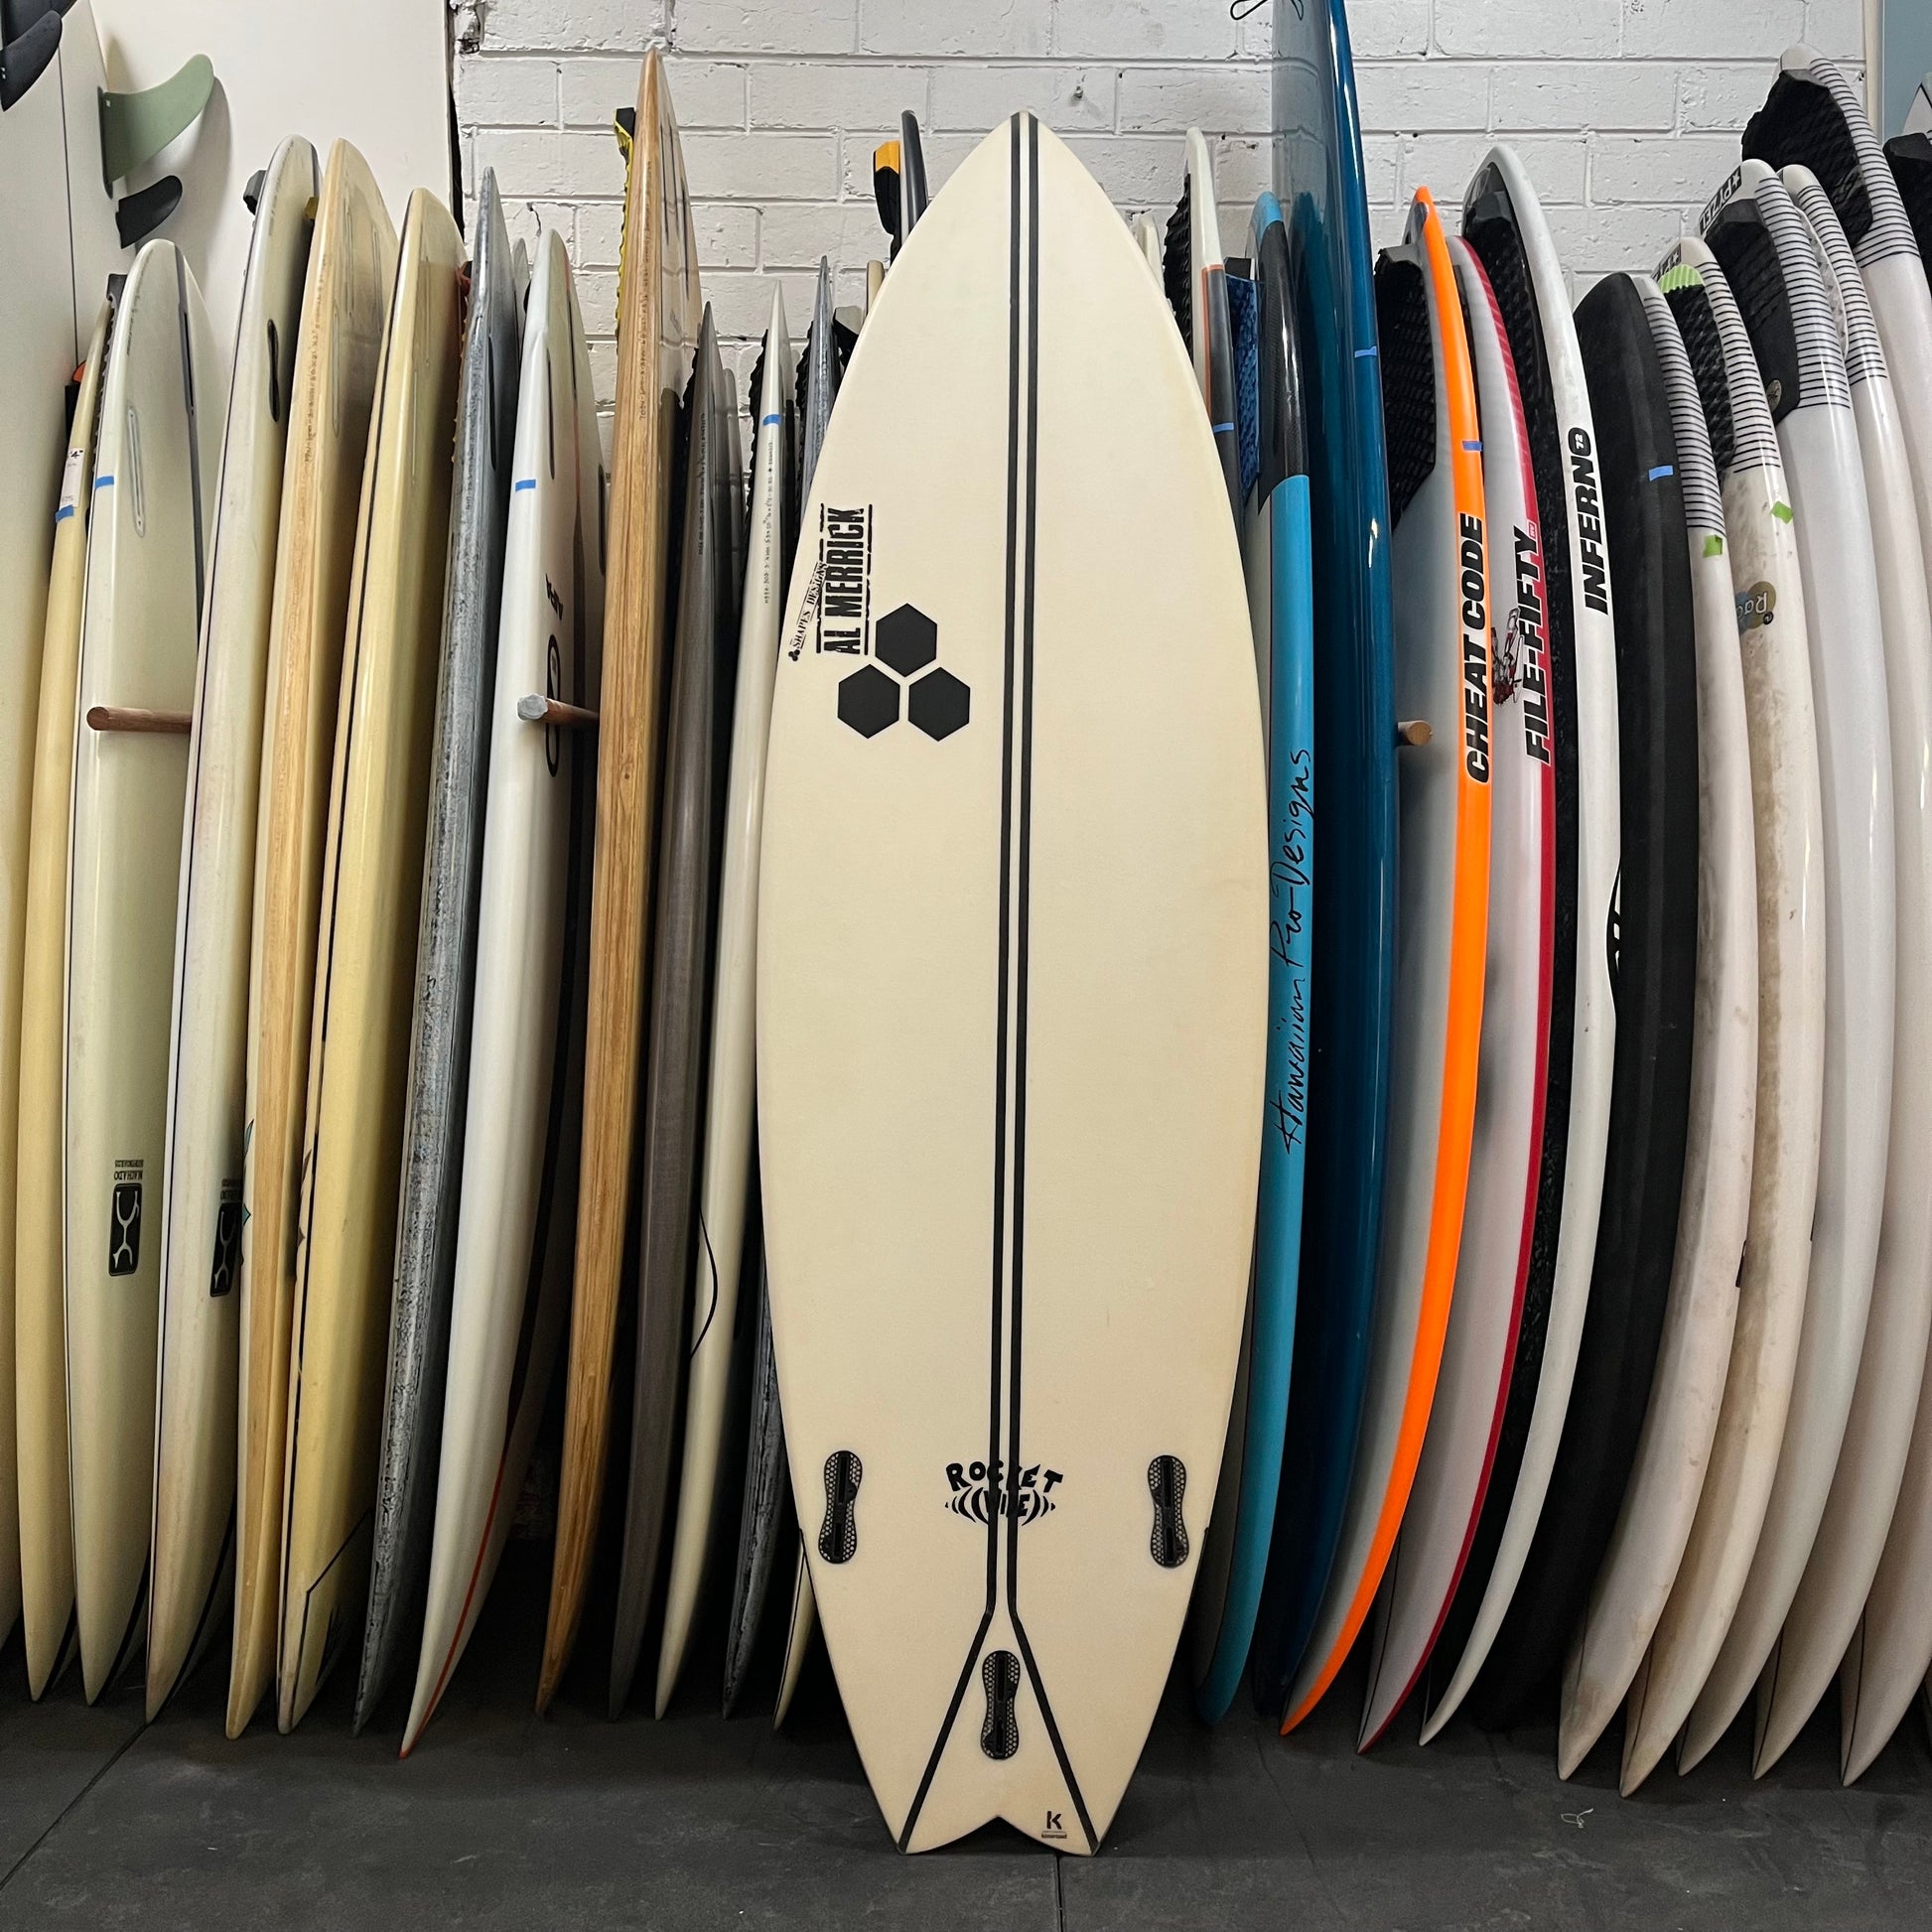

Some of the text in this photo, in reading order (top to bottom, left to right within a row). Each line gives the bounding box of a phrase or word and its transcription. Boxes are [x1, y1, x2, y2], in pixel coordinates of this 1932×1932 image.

[1701, 177, 1733, 230] PYZEL
[1575, 433, 1585, 450] 72
[1568, 427, 1608, 615] INFERNO
[793, 562, 828, 650] SHAPES DESIGNS
[824, 508, 864, 654] AL MERRICK
[1459, 512, 1489, 783] CHEAT CODE
[1513, 524, 1551, 764] FILE-FIFTY
[946, 1460, 1063, 1492] ROCKET
[984, 1489, 1031, 1517] WIE
